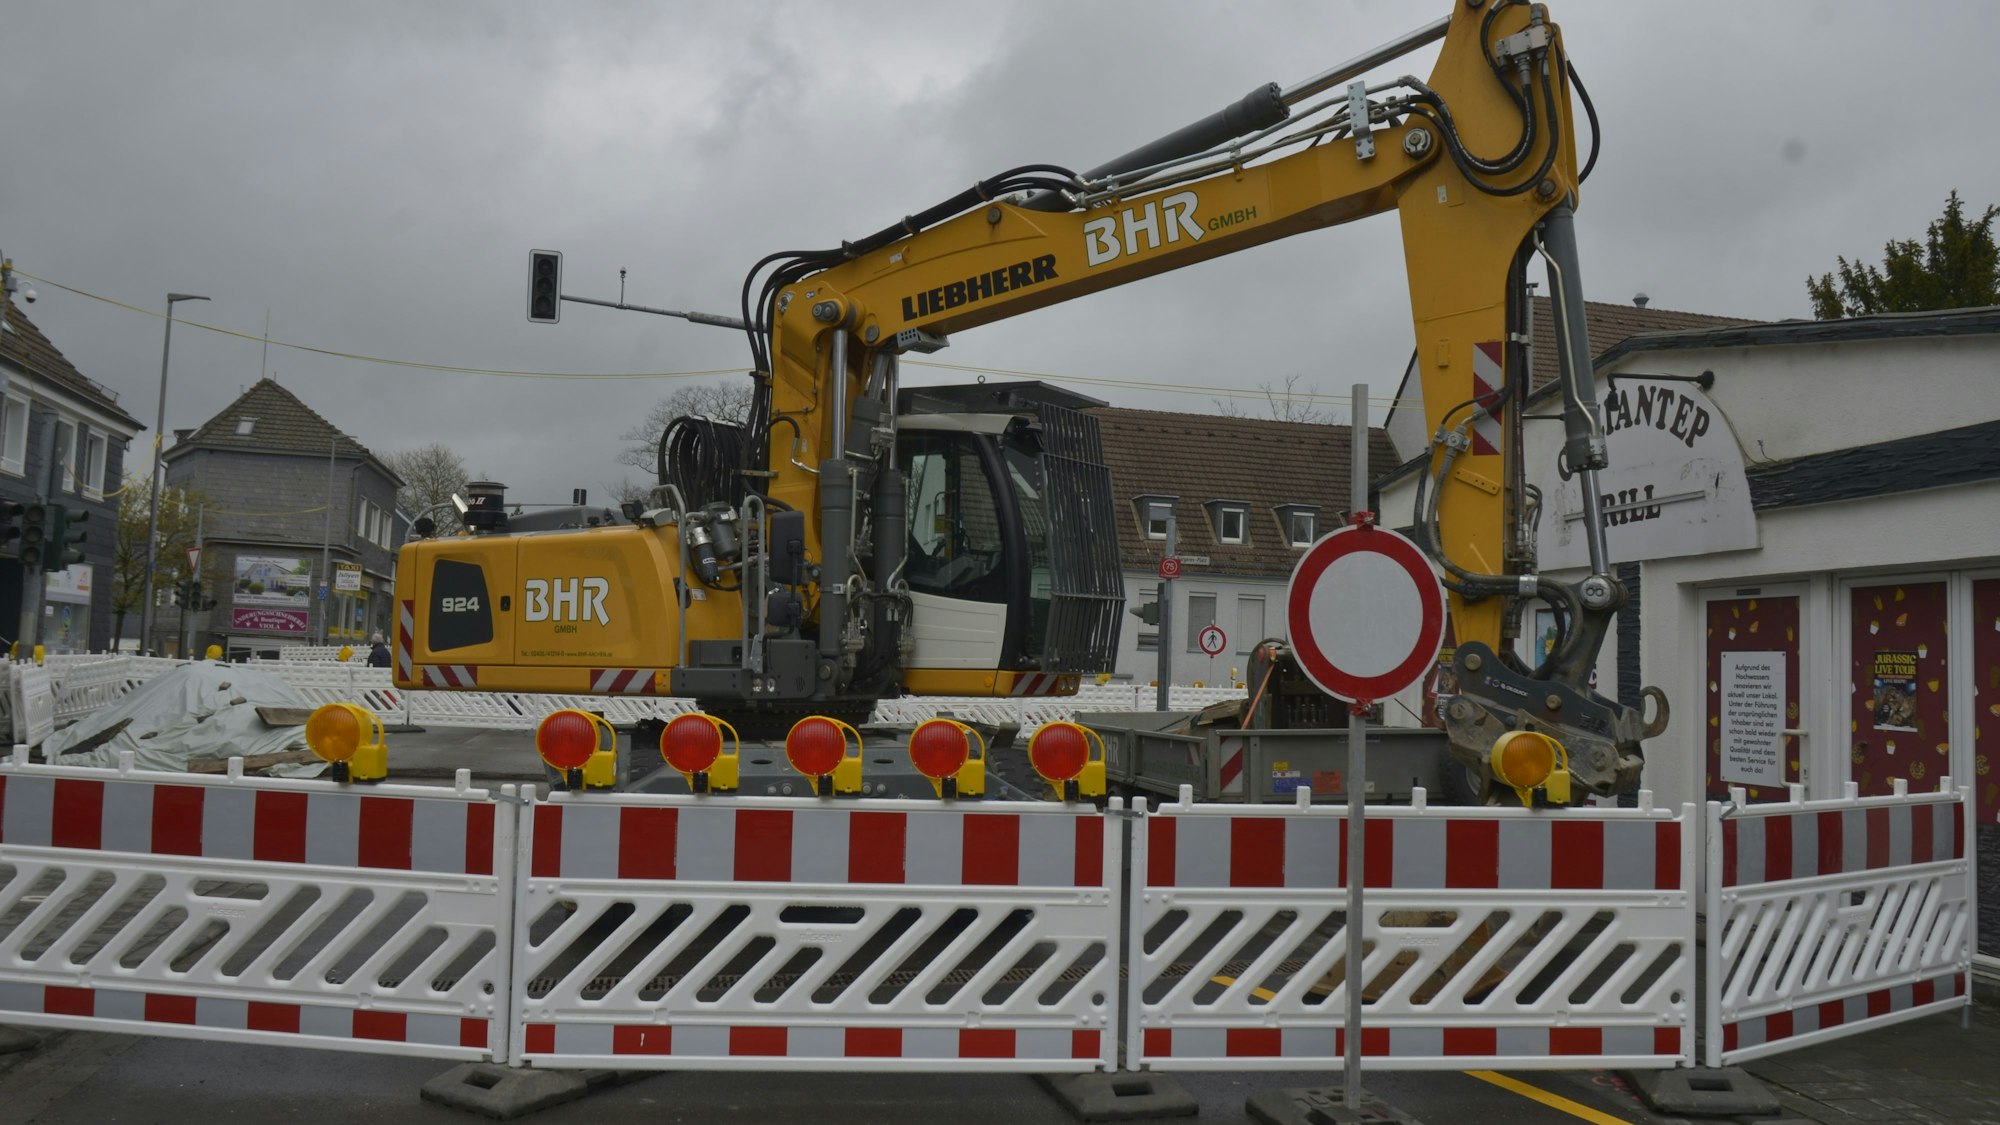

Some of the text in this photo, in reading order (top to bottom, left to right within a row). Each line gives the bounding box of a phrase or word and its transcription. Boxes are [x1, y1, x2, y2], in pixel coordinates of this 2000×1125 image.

[1083, 190, 1257, 267] BHR GMBH
[901, 253, 1060, 322] LIEBHERR
[1583, 484, 1661, 528] RILL
[442, 597, 480, 613] 924
[525, 576, 610, 627] BHR
[554, 624, 577, 634] GMBH
[1875, 654, 1917, 665] JURASSIC
[1735, 664, 1760, 672] Aufgrund
[1874, 664, 1916, 675] LIVE TOUR
[1754, 701, 1777, 710] Führung
[1738, 710, 1778, 719] ursprünglichen
[1729, 755, 1747, 763] besten
[1747, 756, 1766, 764] Service
